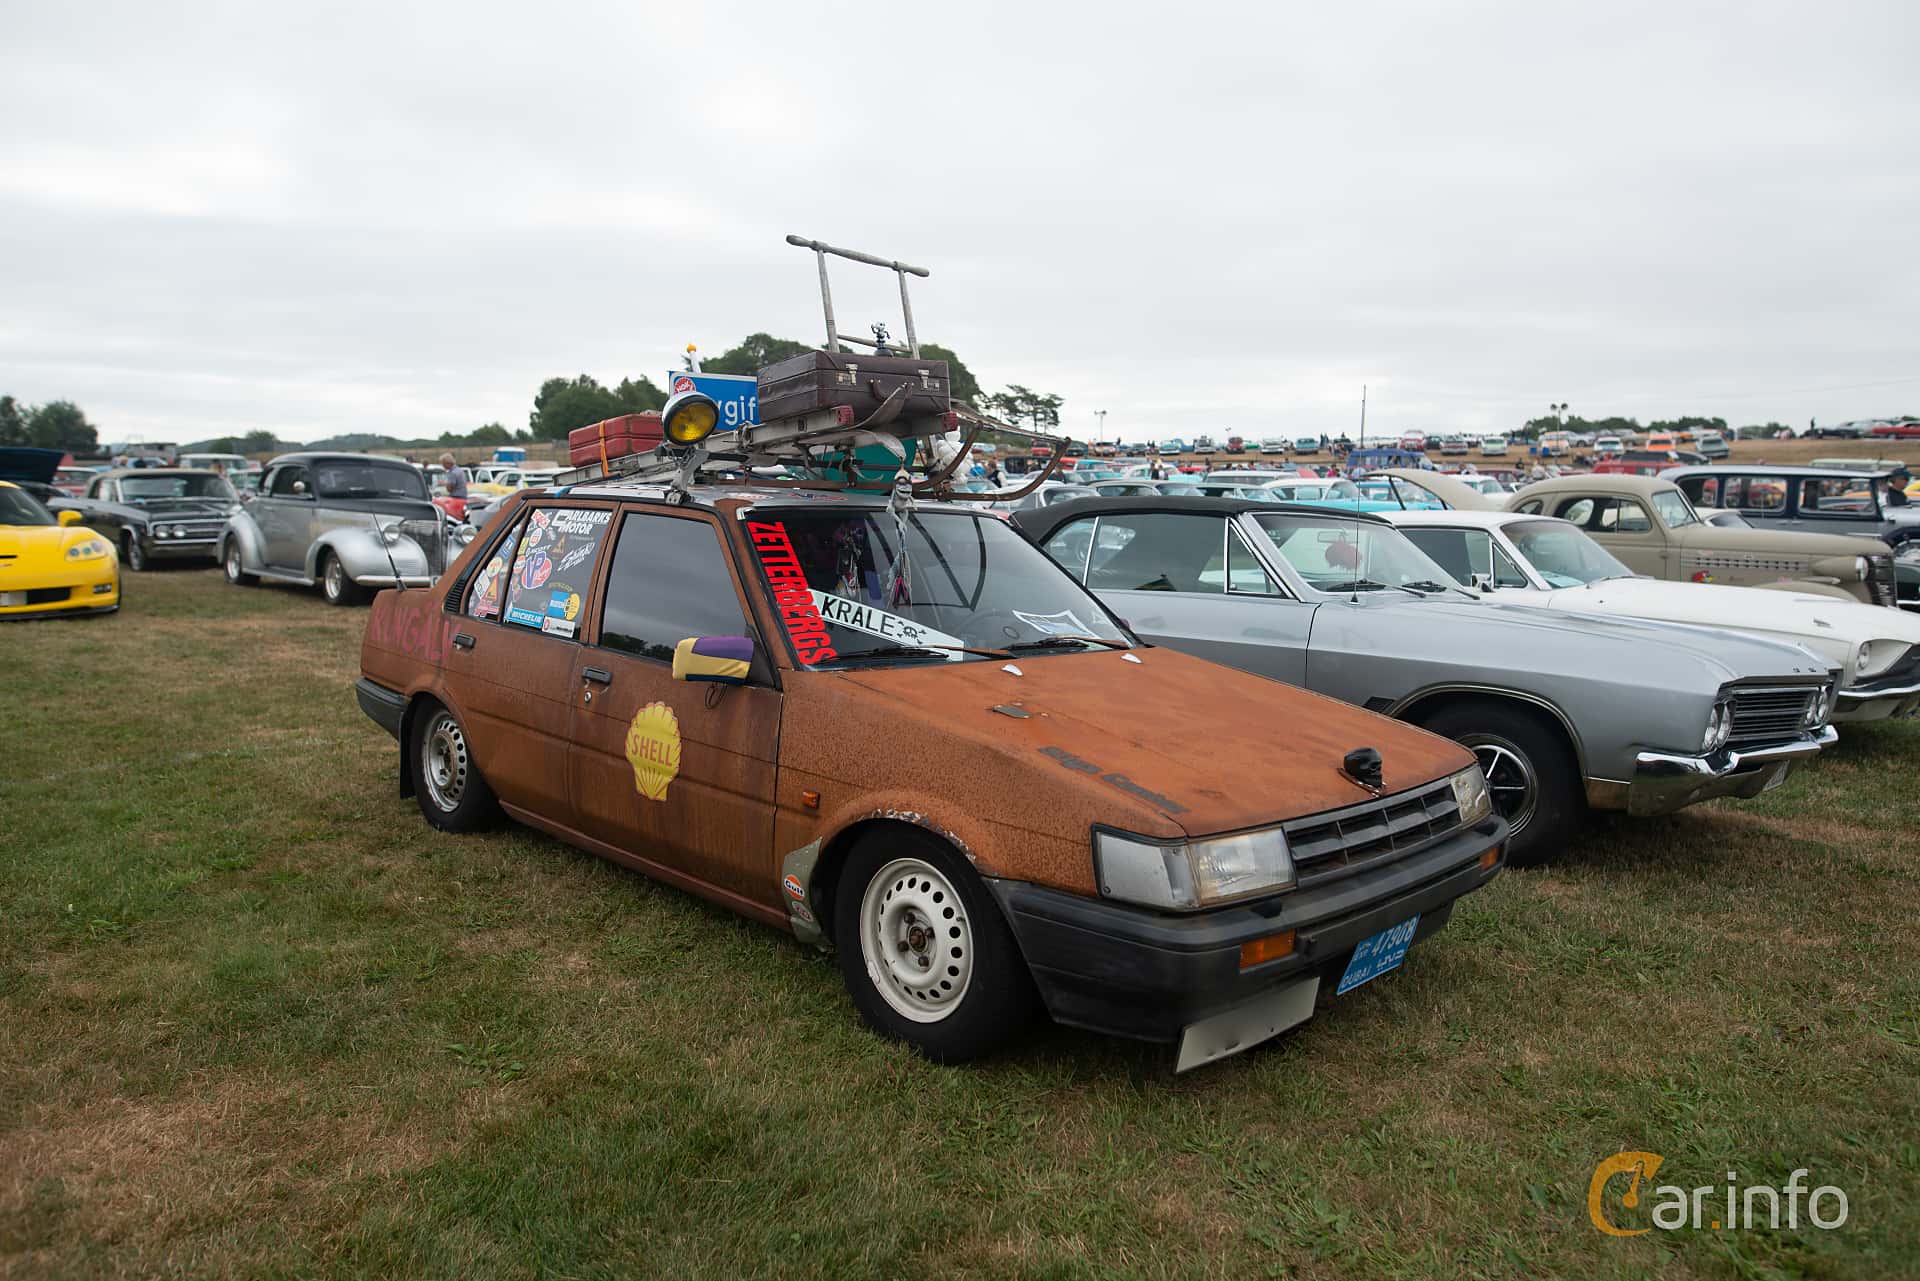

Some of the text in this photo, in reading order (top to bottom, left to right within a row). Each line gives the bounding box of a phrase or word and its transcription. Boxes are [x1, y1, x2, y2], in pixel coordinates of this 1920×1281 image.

[558, 521, 593, 534] MOTOR
[747, 521, 838, 665] ZETTERBERGS
[511, 611, 542, 623] MICHELIN
[821, 596, 897, 637] KRALE
[631, 734, 673, 767] SHELL
[1371, 917, 1417, 956] 47908
[1341, 967, 1372, 989] DUBAI
